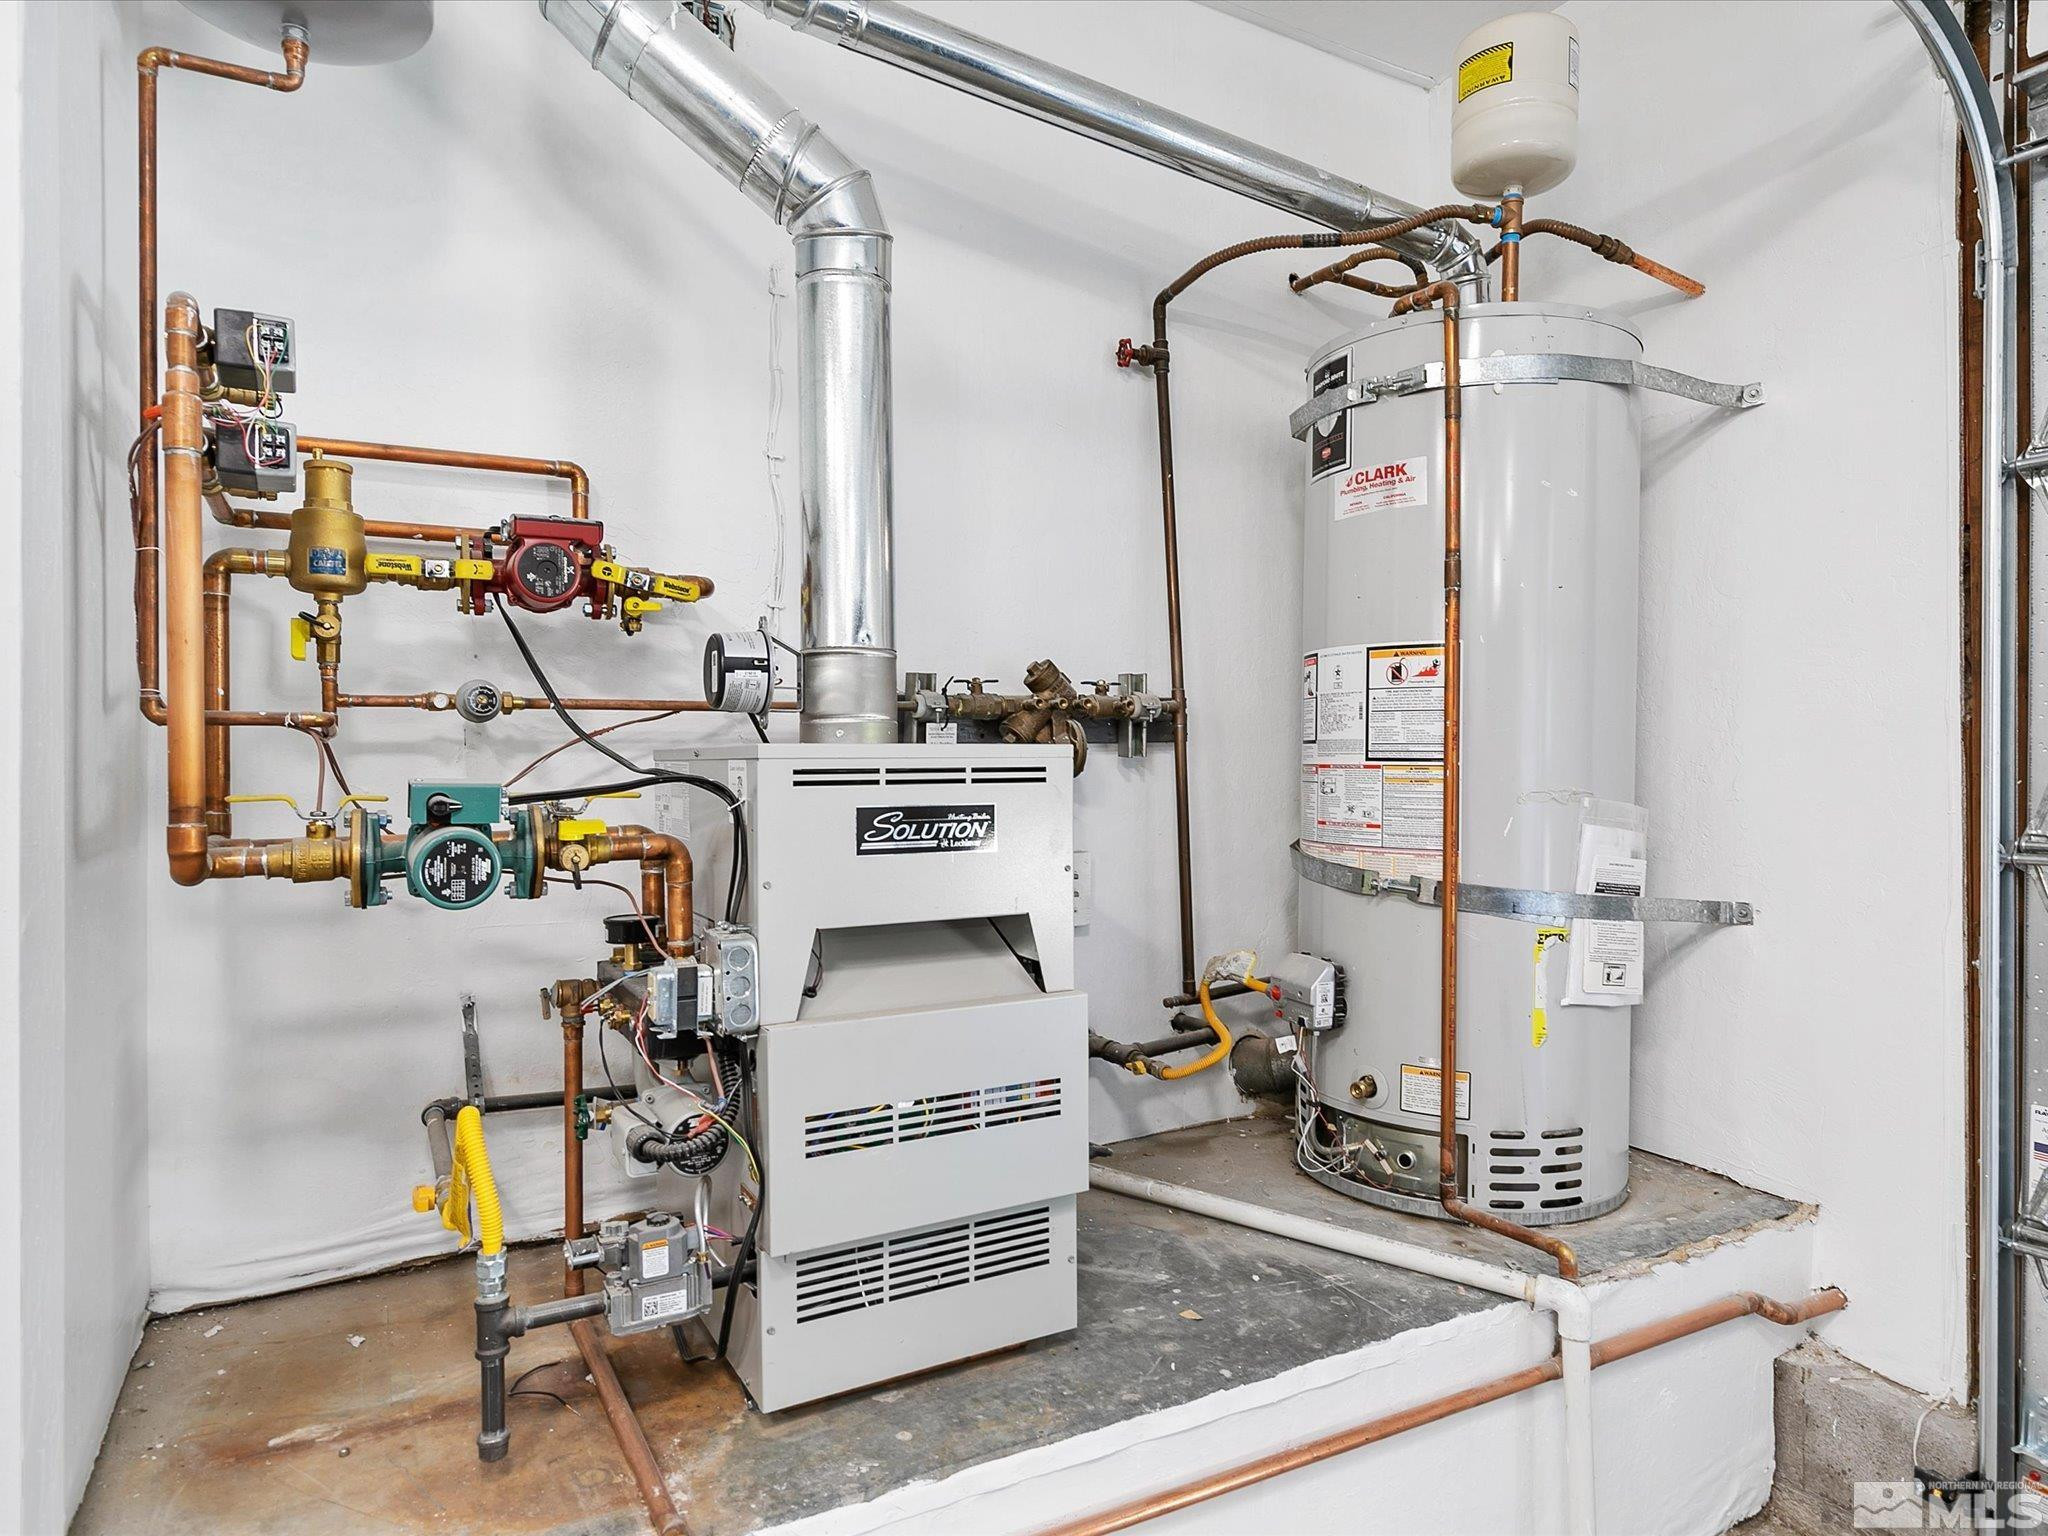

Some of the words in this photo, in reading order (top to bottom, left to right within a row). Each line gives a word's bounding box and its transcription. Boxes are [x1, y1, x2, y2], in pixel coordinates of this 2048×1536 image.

[1355, 463, 1408, 485] CLARK
[1369, 479, 1397, 490] Heating
[1405, 475, 1416, 483] Air
[864, 811, 988, 841] SOLUTION
